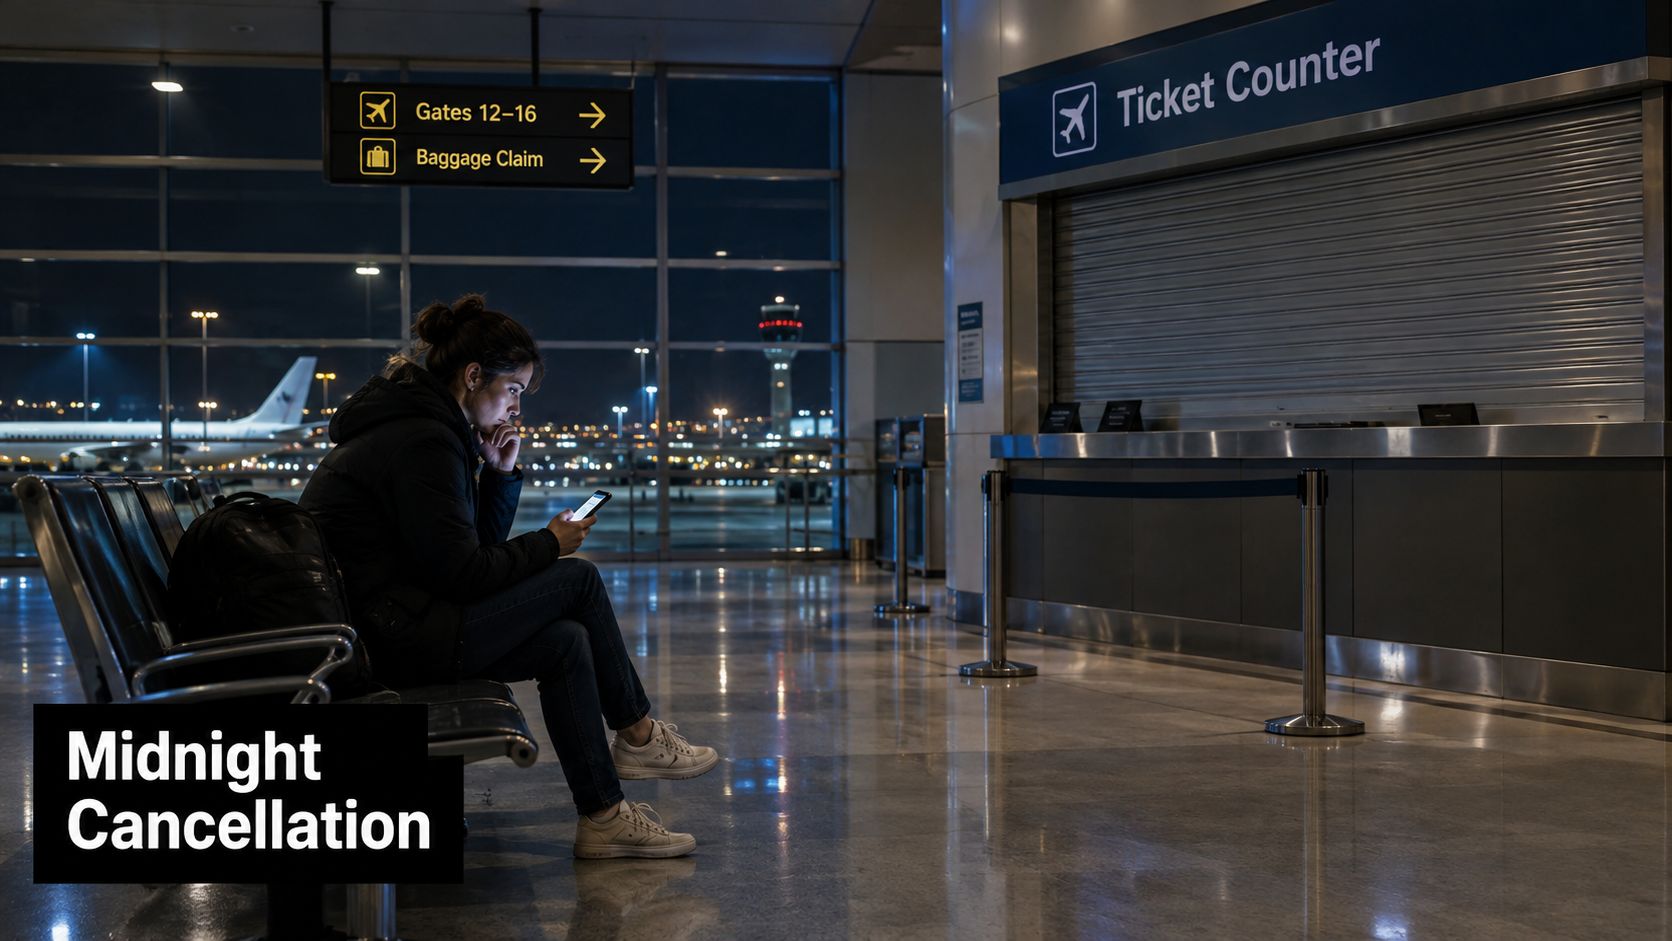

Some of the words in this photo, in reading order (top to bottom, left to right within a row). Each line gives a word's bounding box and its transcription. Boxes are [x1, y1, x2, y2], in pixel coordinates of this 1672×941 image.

[1117, 72, 1215, 127] Ticket
[1226, 38, 1380, 102] Counter
[415, 102, 472, 122] Gates
[479, 103, 537, 123] 12–16
[416, 148, 492, 170] Baggage
[496, 149, 544, 168] Claim
